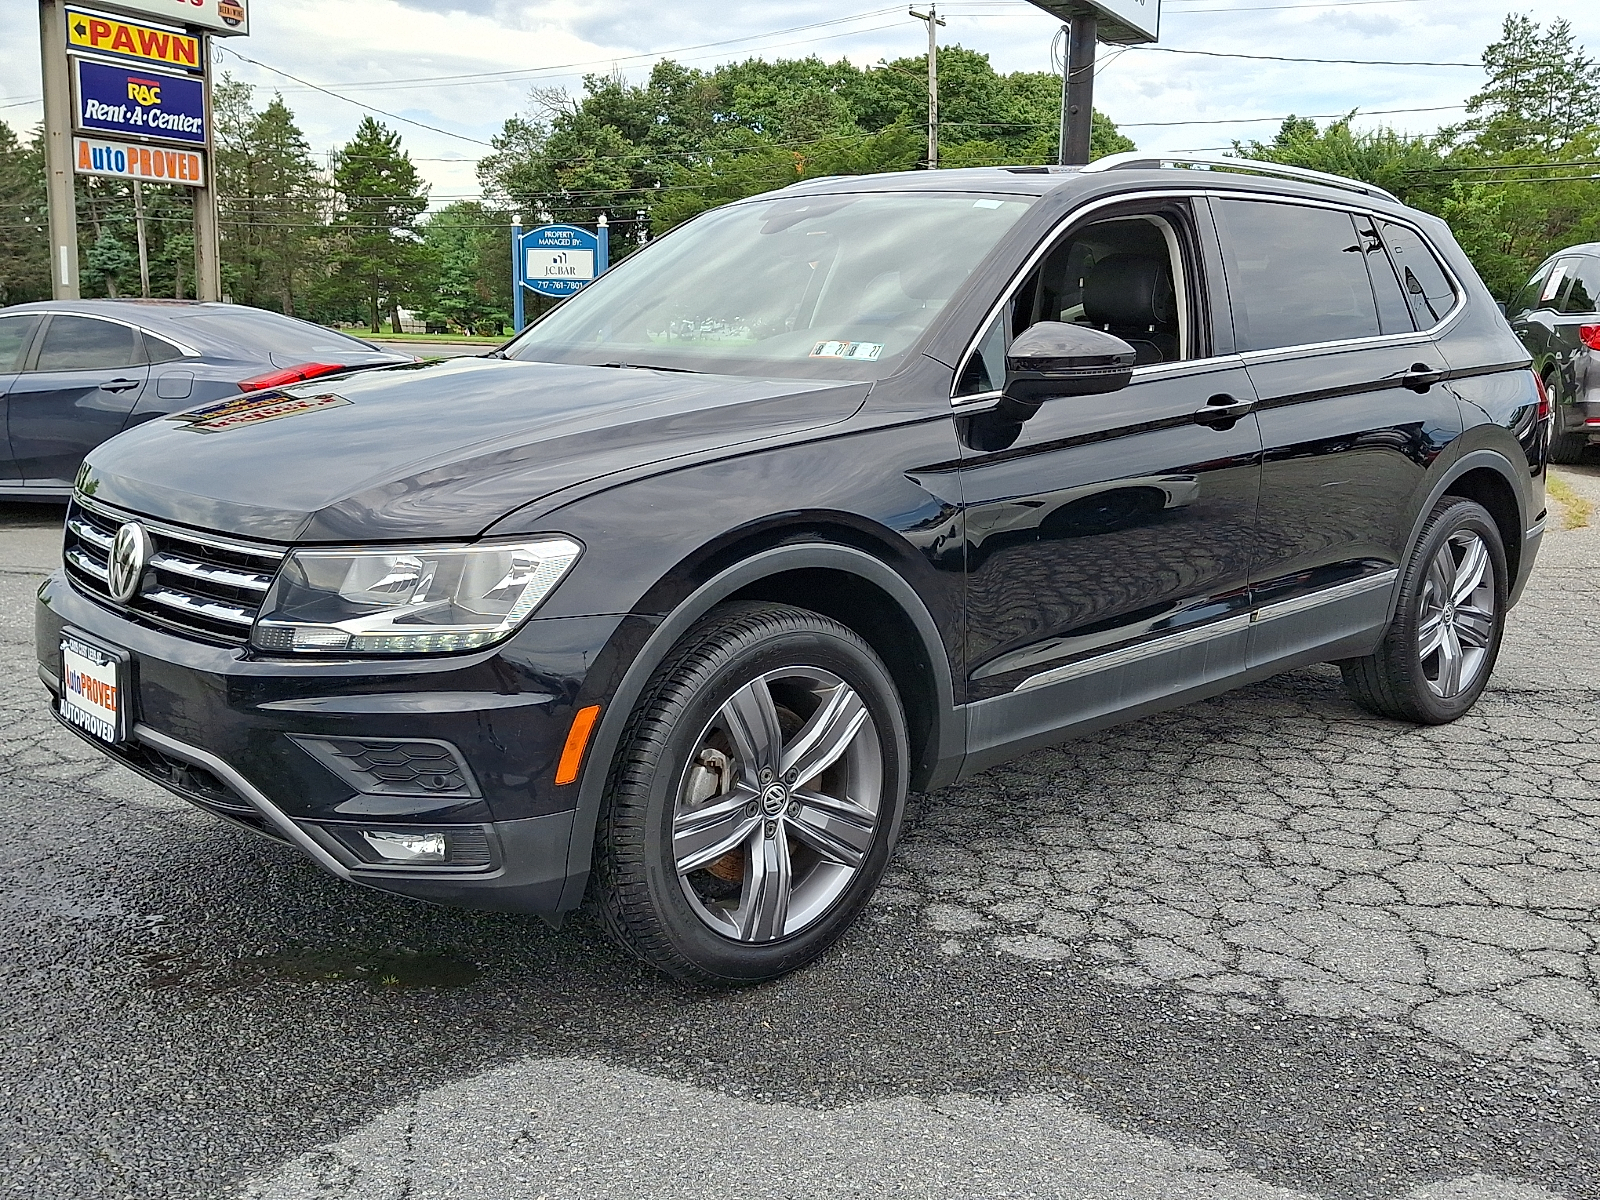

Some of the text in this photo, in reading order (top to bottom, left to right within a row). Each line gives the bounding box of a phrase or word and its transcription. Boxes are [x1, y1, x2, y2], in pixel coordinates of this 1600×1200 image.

[89, 19, 195, 64] PAWN
[128, 83, 162, 106] RAC
[79, 141, 199, 181] AutoPROVED
[538, 238, 571, 246] MANAGED
[537, 281, 583, 289] 717-761-7801
[66, 664, 117, 712] AutoPROVED
[60, 698, 115, 743] AUTOPROVED
